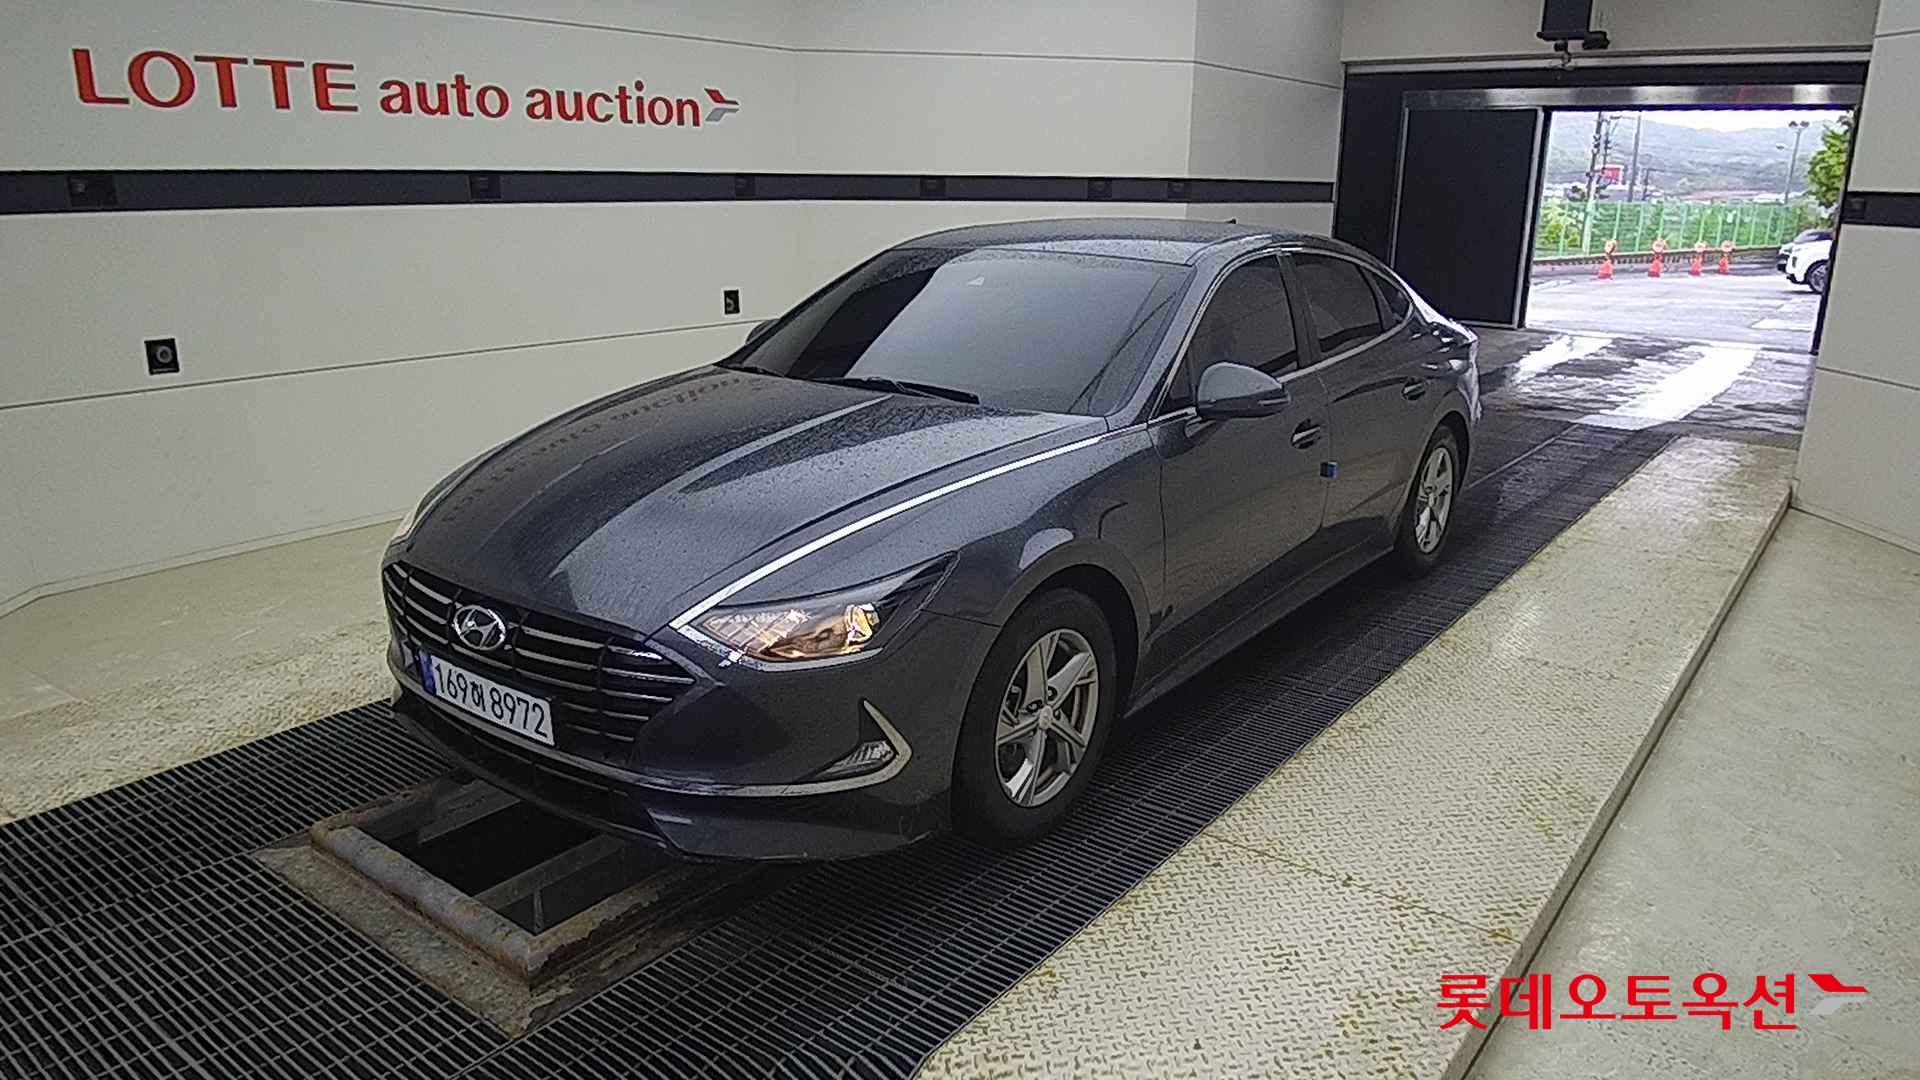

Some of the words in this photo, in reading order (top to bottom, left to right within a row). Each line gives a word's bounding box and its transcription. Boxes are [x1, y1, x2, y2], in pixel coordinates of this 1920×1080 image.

[72, 48, 359, 112] LOTTE
[380, 74, 510, 118] auto
[526, 80, 701, 127] auction
[489, 687, 548, 738] 8972
